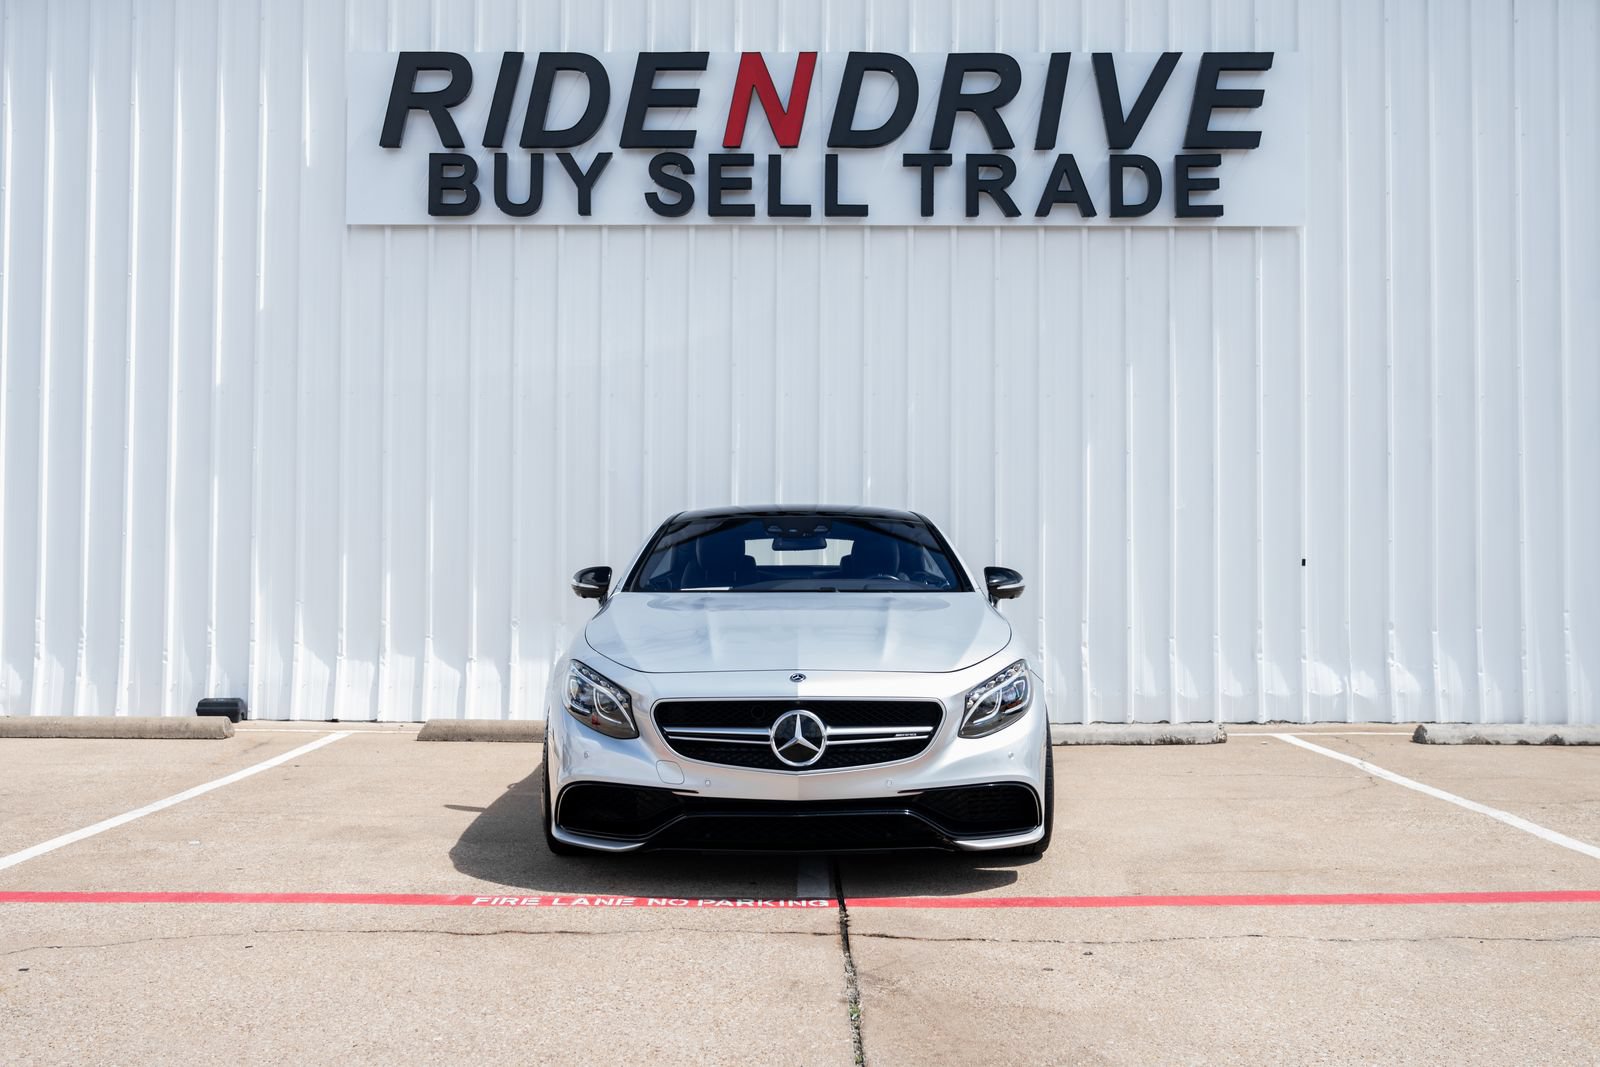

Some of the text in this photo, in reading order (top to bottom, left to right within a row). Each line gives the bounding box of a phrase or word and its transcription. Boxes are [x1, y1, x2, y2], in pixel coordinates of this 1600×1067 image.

[428, 152, 1225, 218] BUY SELL TRADE
[471, 897, 830, 907] FIRE LANE NO PARKING
